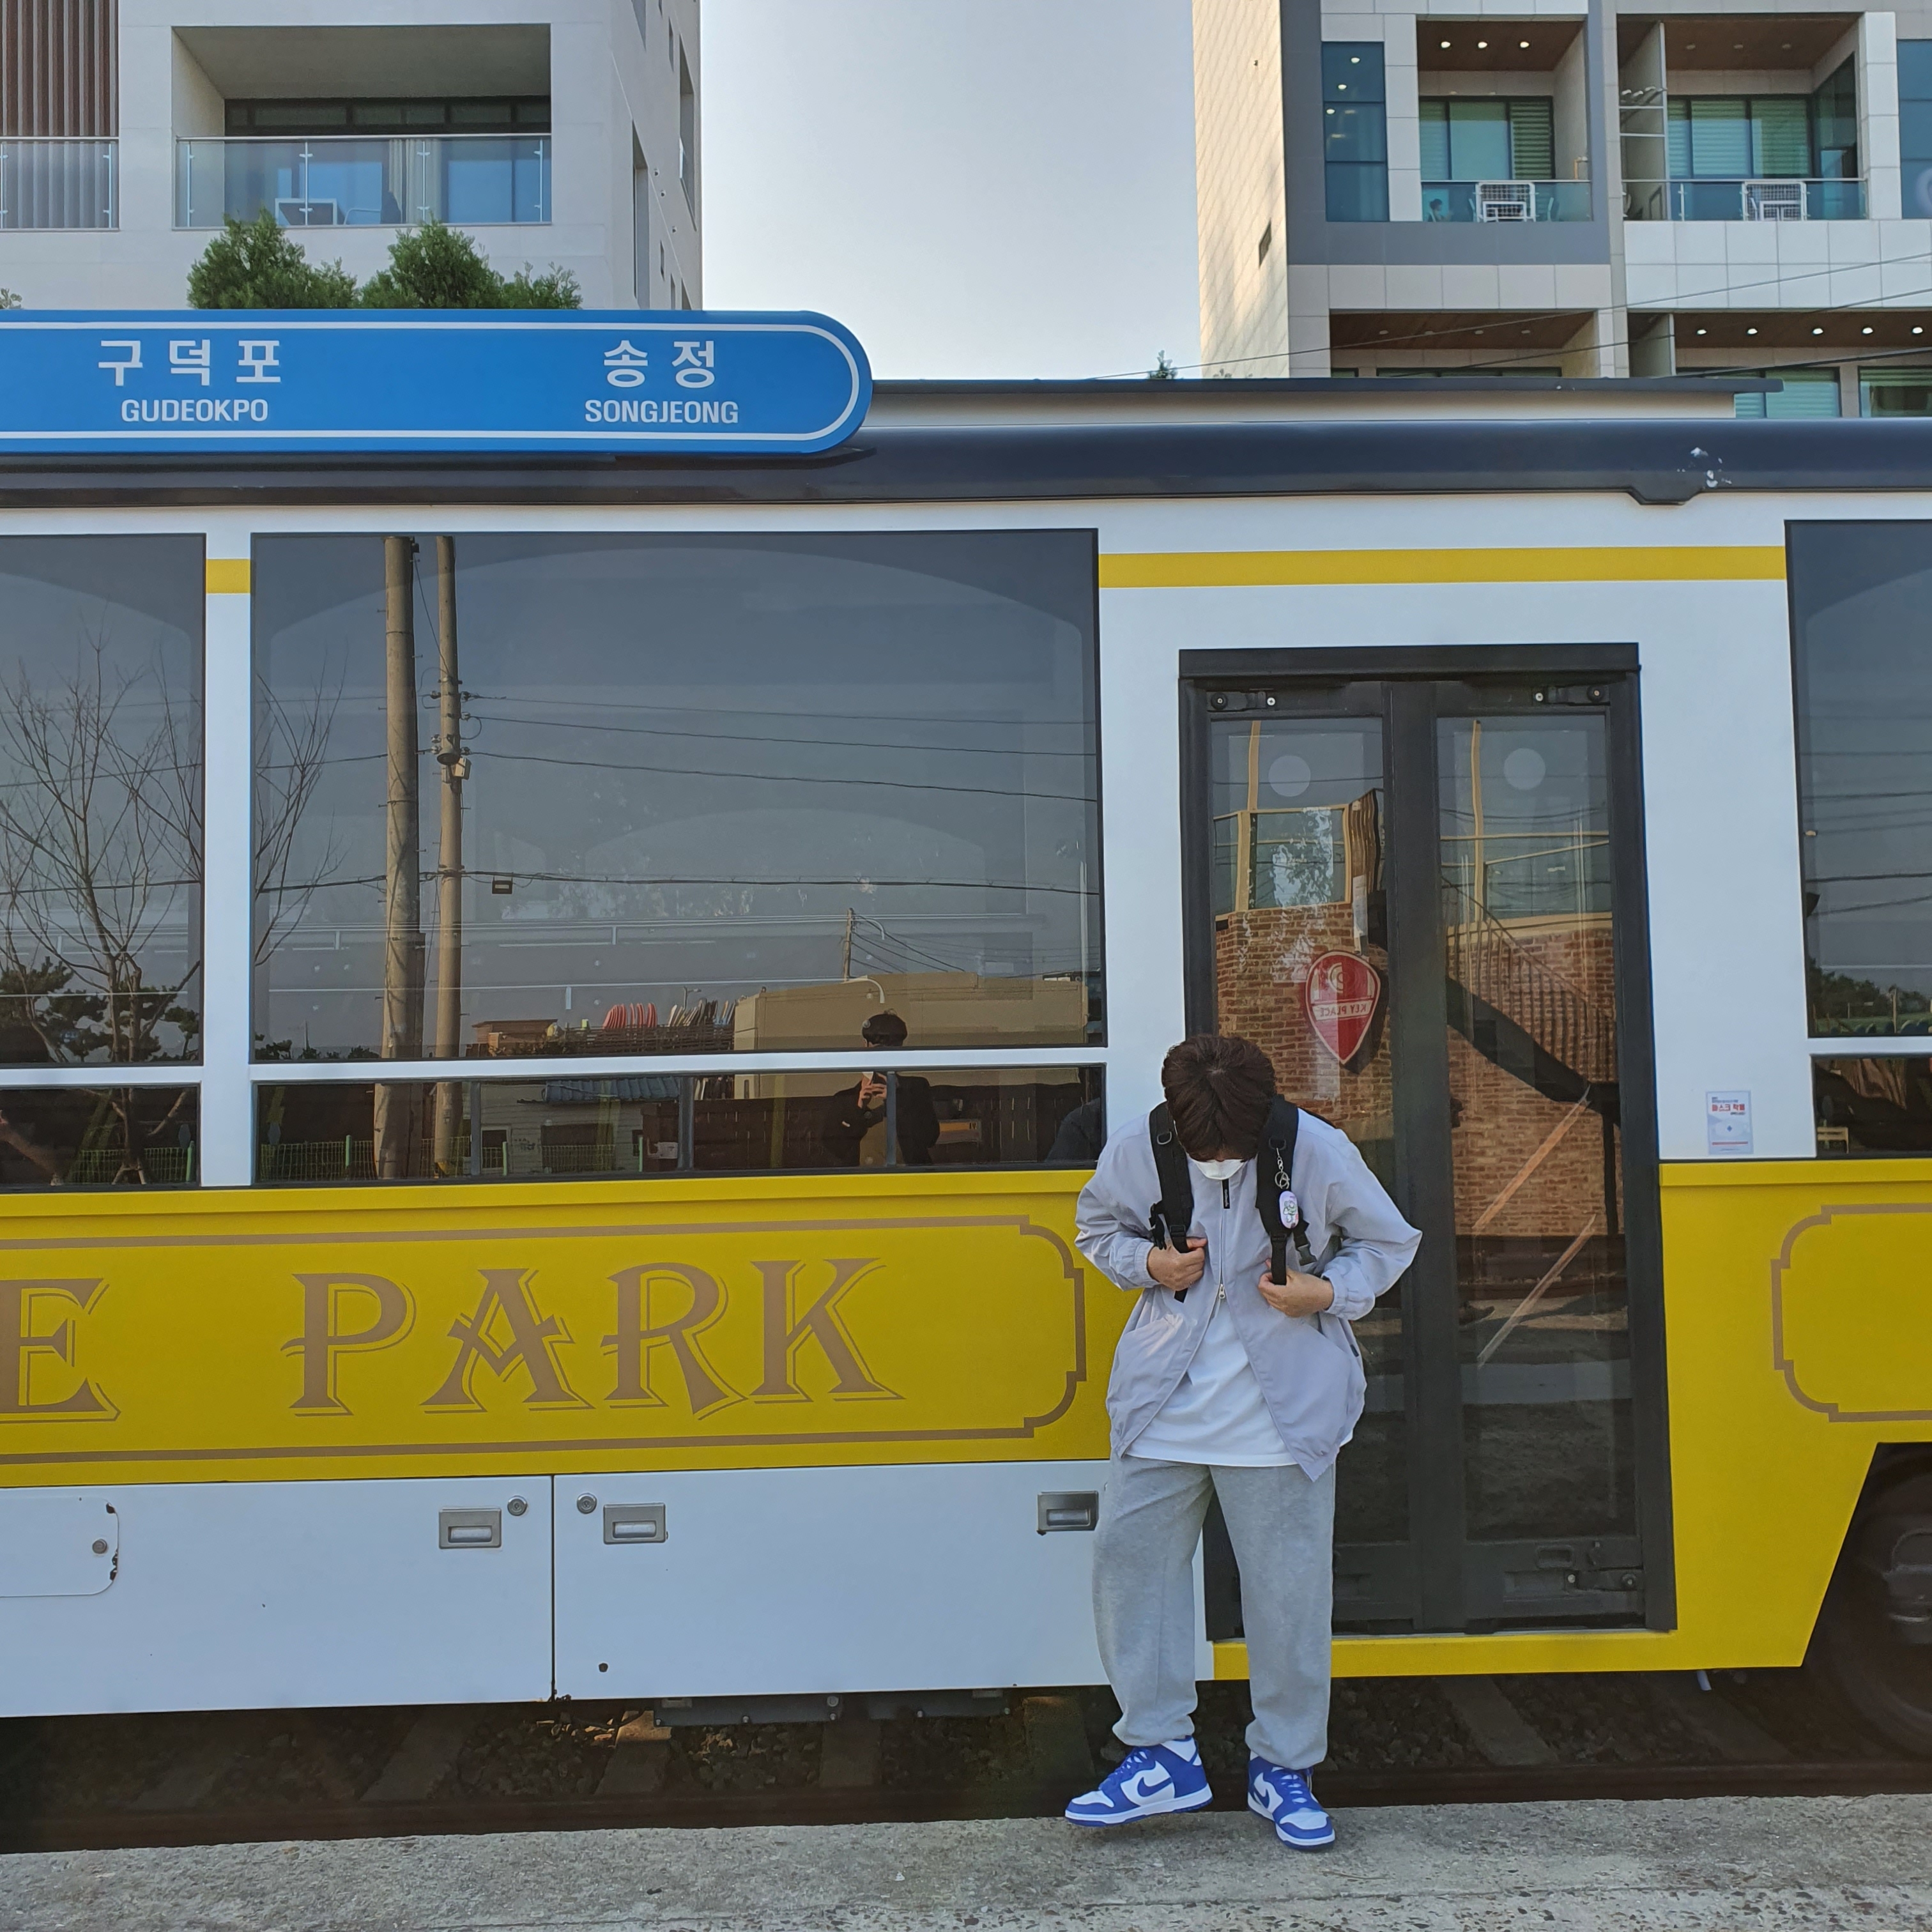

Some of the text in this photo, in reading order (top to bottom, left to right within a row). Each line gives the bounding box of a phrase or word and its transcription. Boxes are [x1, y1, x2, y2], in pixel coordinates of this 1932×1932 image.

[98, 339, 281, 387] 구덕포
[603, 340, 715, 388] 송정
[121, 399, 268, 422] GUDEOKPO
[585, 399, 739, 424] SONGJEONG
[280, 1257, 906, 1420] PARK
